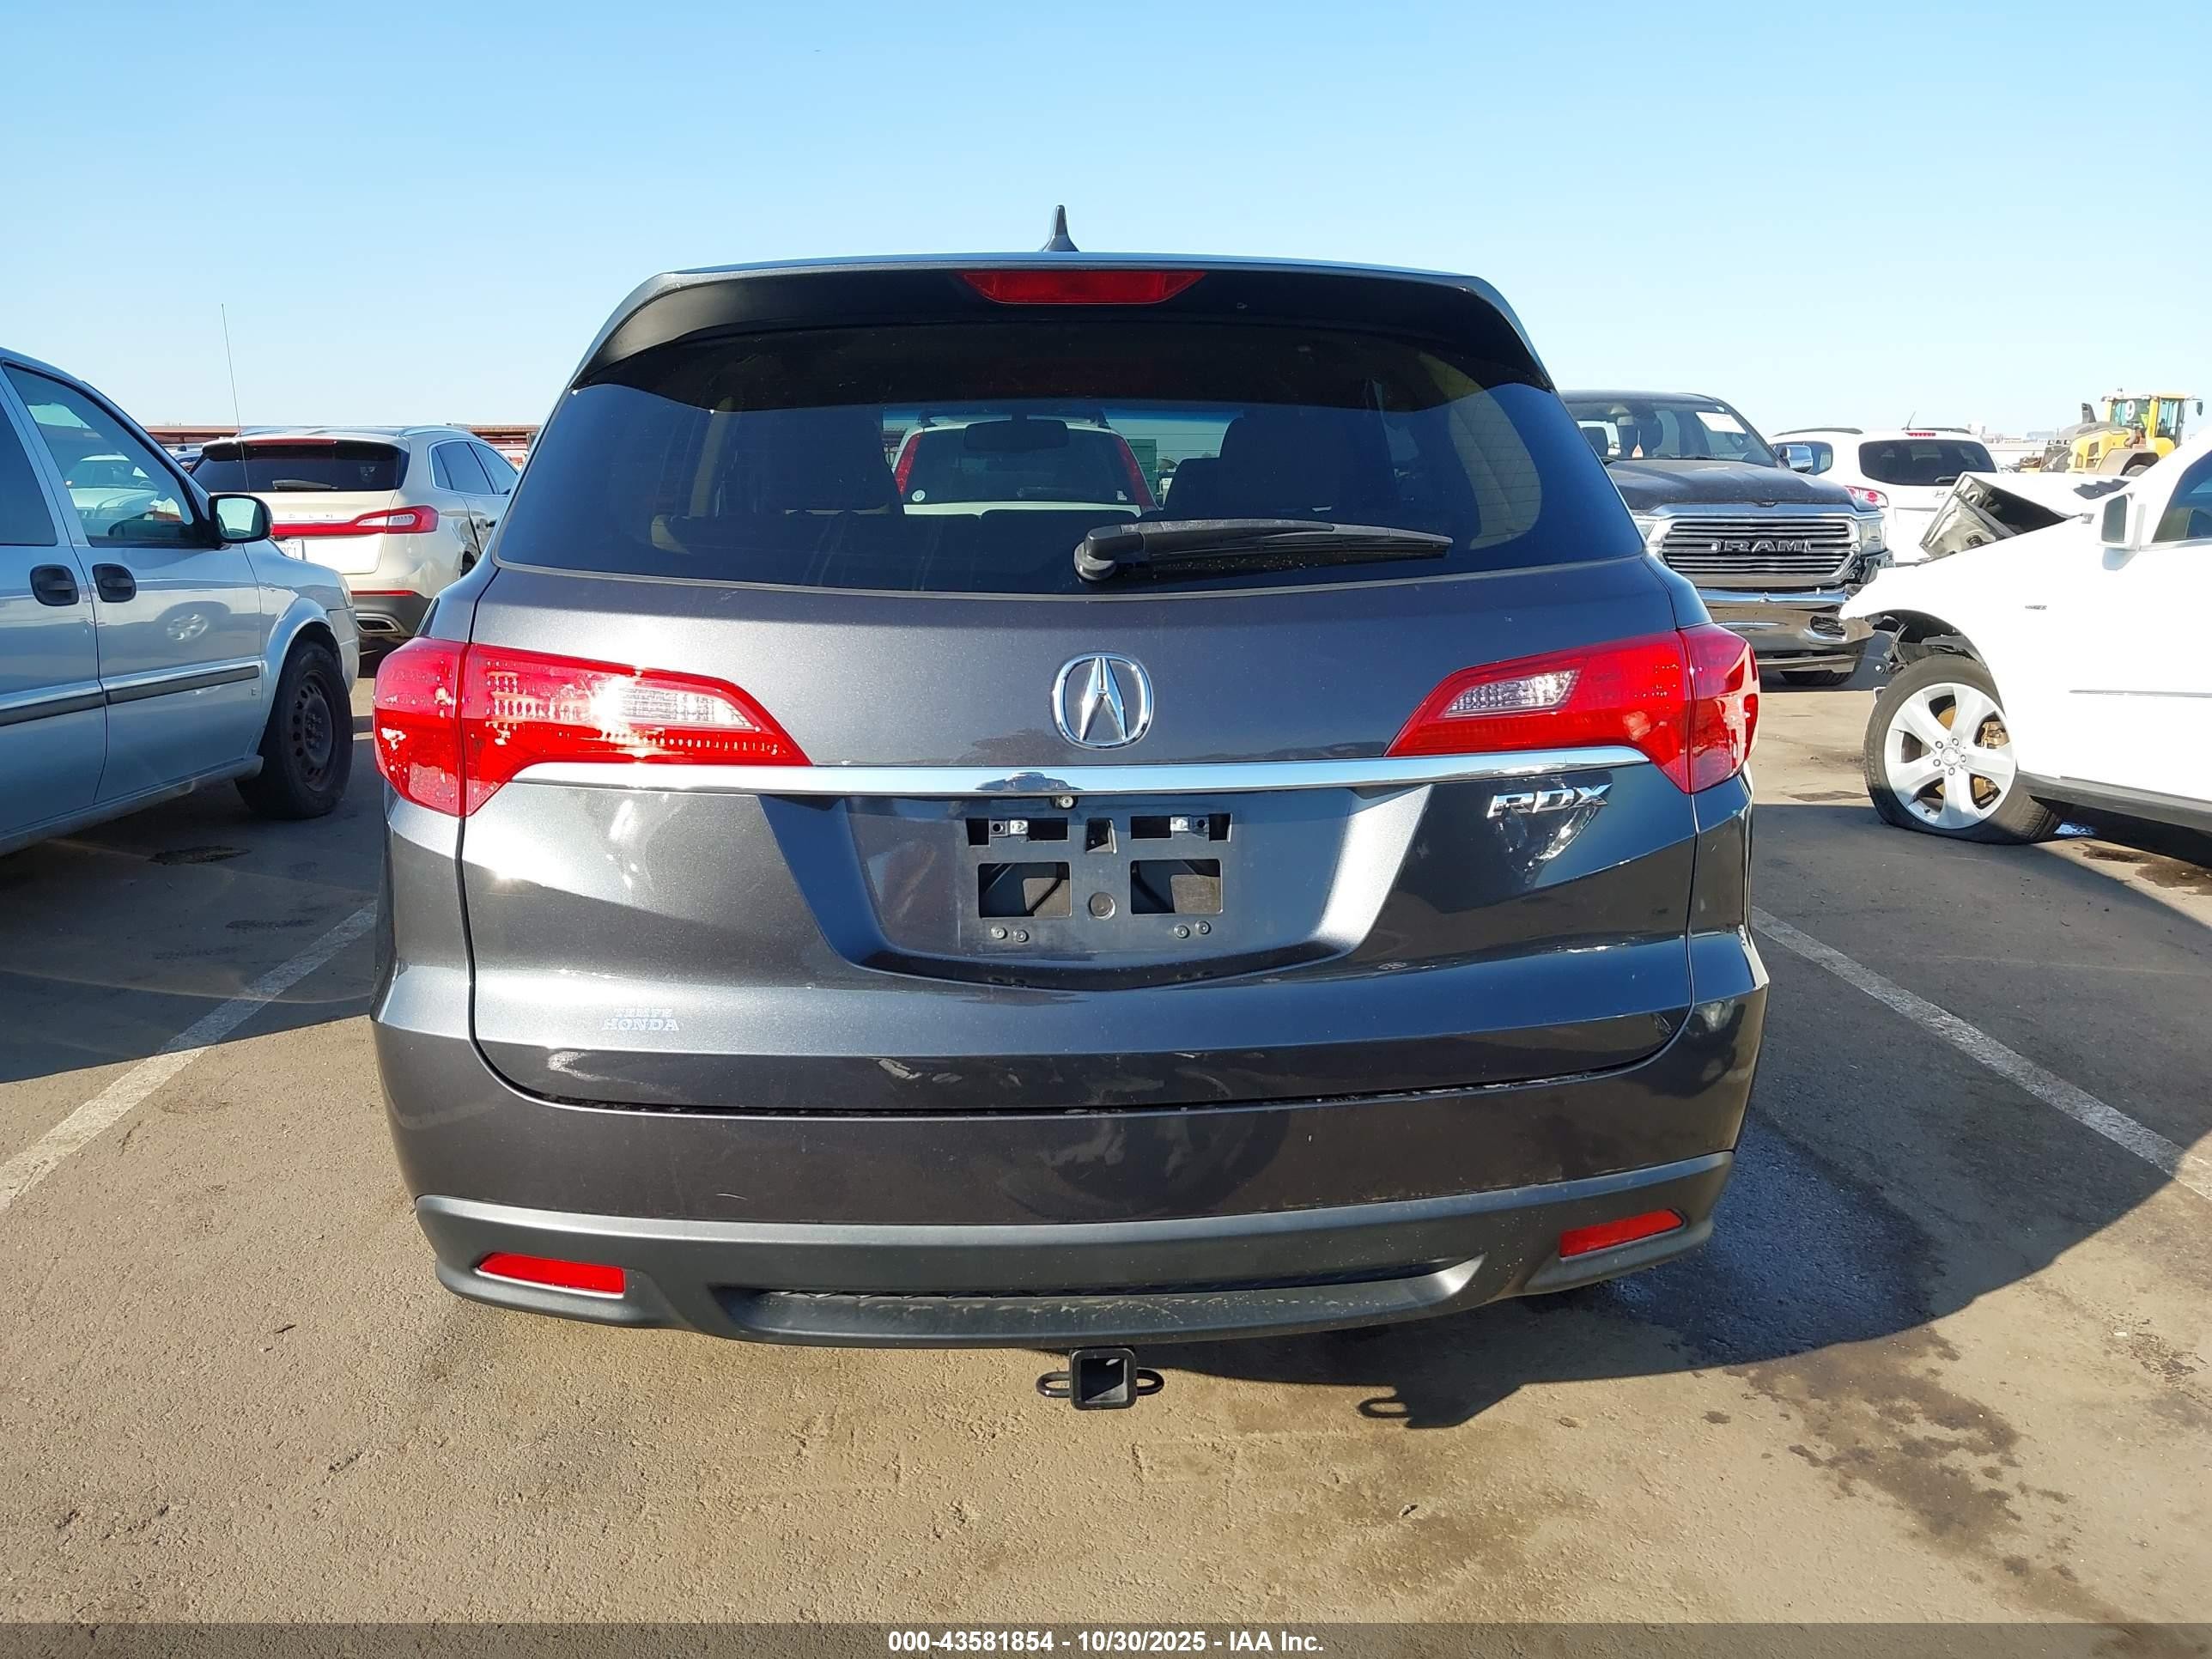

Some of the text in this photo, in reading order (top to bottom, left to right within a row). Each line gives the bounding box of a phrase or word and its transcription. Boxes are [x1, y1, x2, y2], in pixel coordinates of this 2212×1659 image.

[1723, 539, 1808, 553] RAM
[1486, 782, 1613, 818] RDX
[602, 1018, 680, 1031] HONDA
